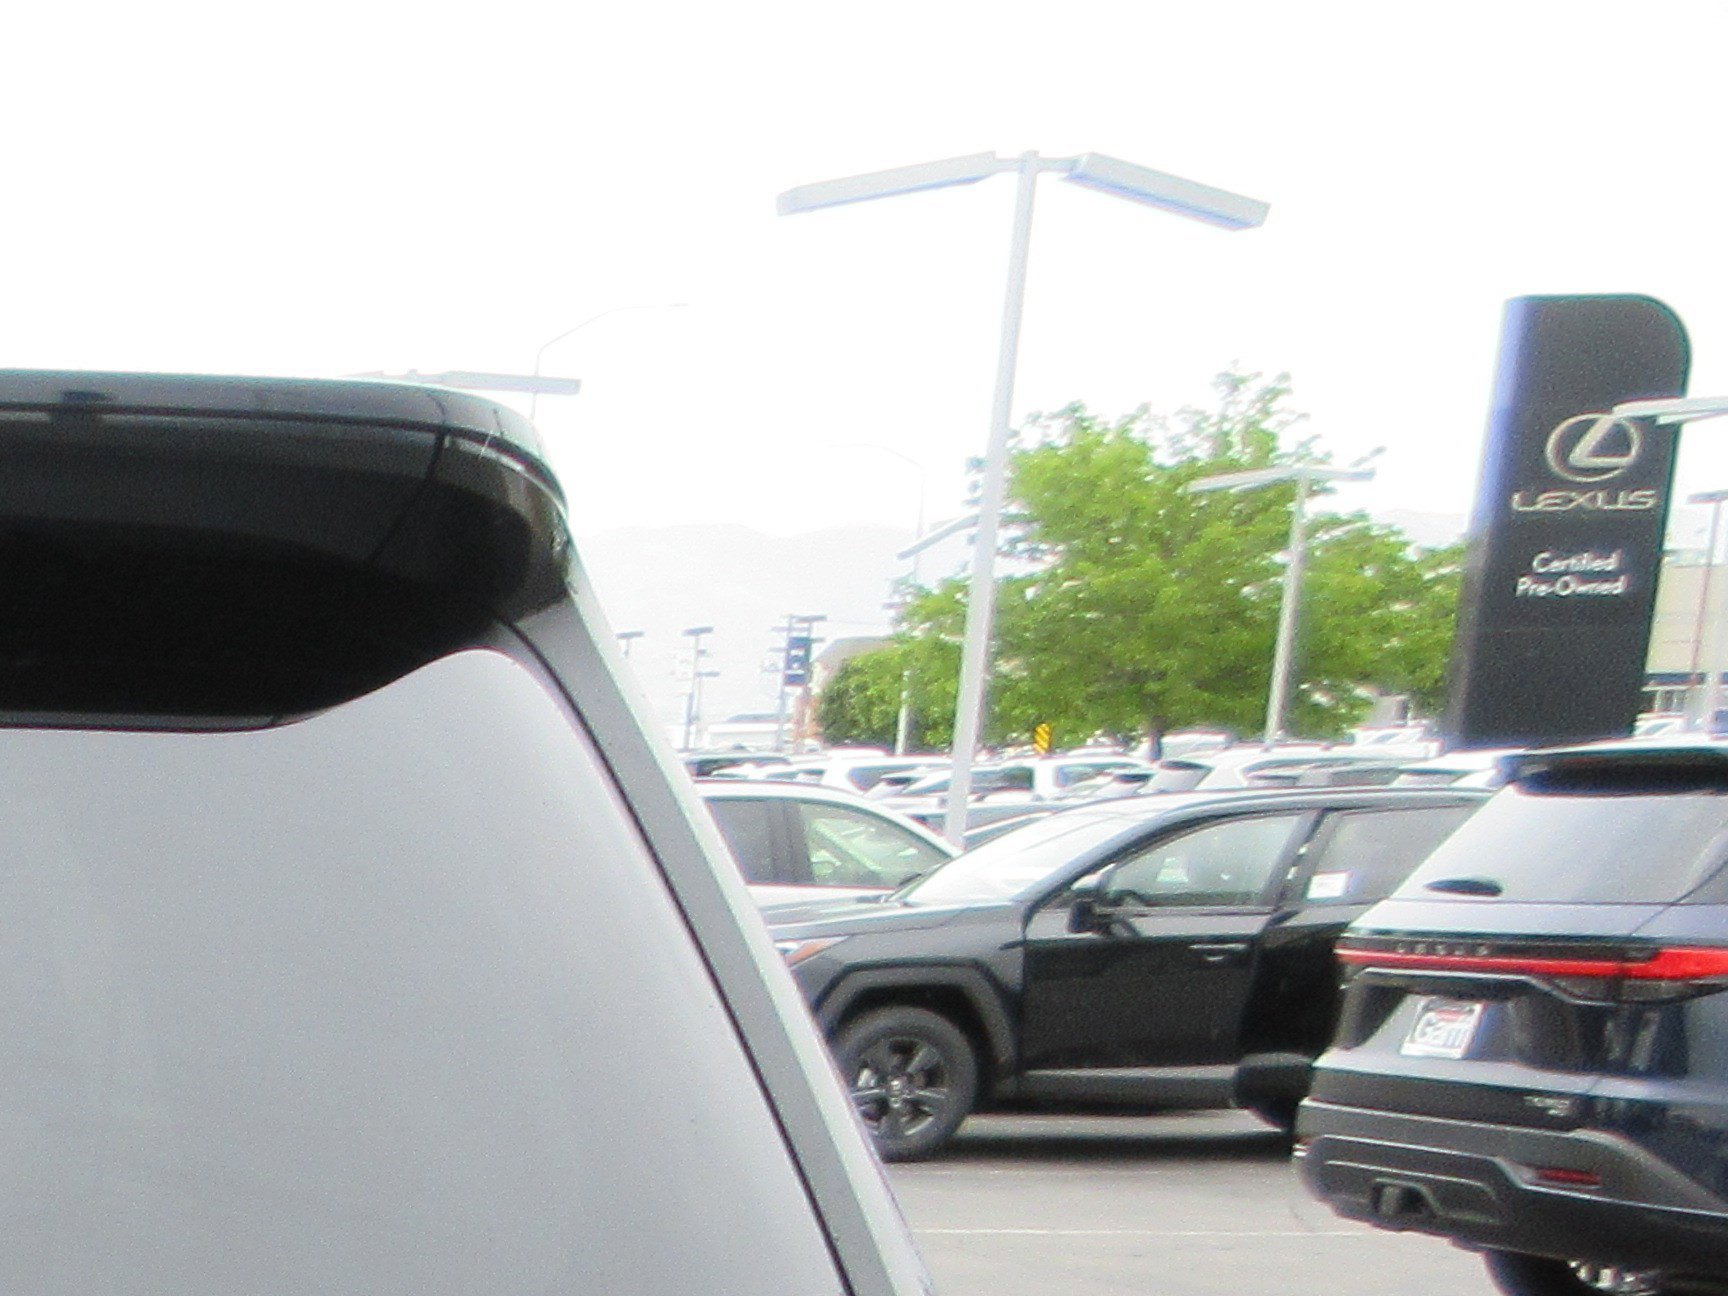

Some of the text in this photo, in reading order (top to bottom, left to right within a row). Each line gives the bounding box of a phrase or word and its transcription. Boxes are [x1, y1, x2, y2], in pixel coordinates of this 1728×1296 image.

[1511, 487, 1658, 513] LEXUS
[1531, 549, 1623, 573] Certified
[1515, 574, 1630, 597] Pre-Owned
